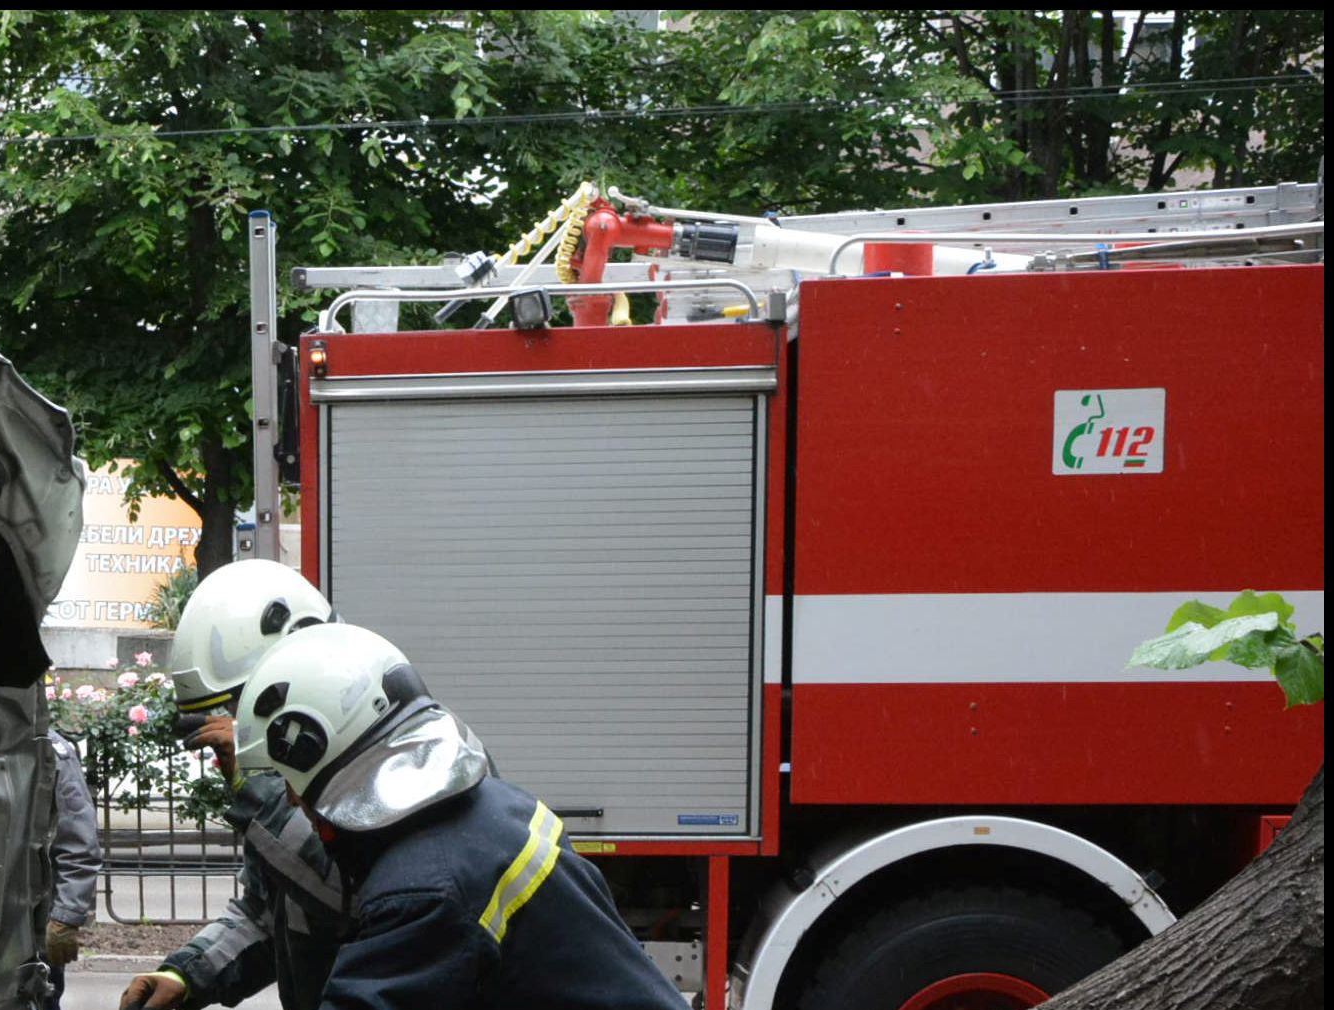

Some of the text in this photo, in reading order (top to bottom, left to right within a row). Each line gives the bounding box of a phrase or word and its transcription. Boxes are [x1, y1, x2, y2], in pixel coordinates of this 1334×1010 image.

[1096, 426, 1156, 457] 112
[86, 476, 114, 495] РА
[79, 524, 202, 549] ЕБЕЛИ ДРЕХ
[85, 553, 185, 574] ТЕХНИКА
[59, 600, 153, 621] ОТ ГЕРМ
